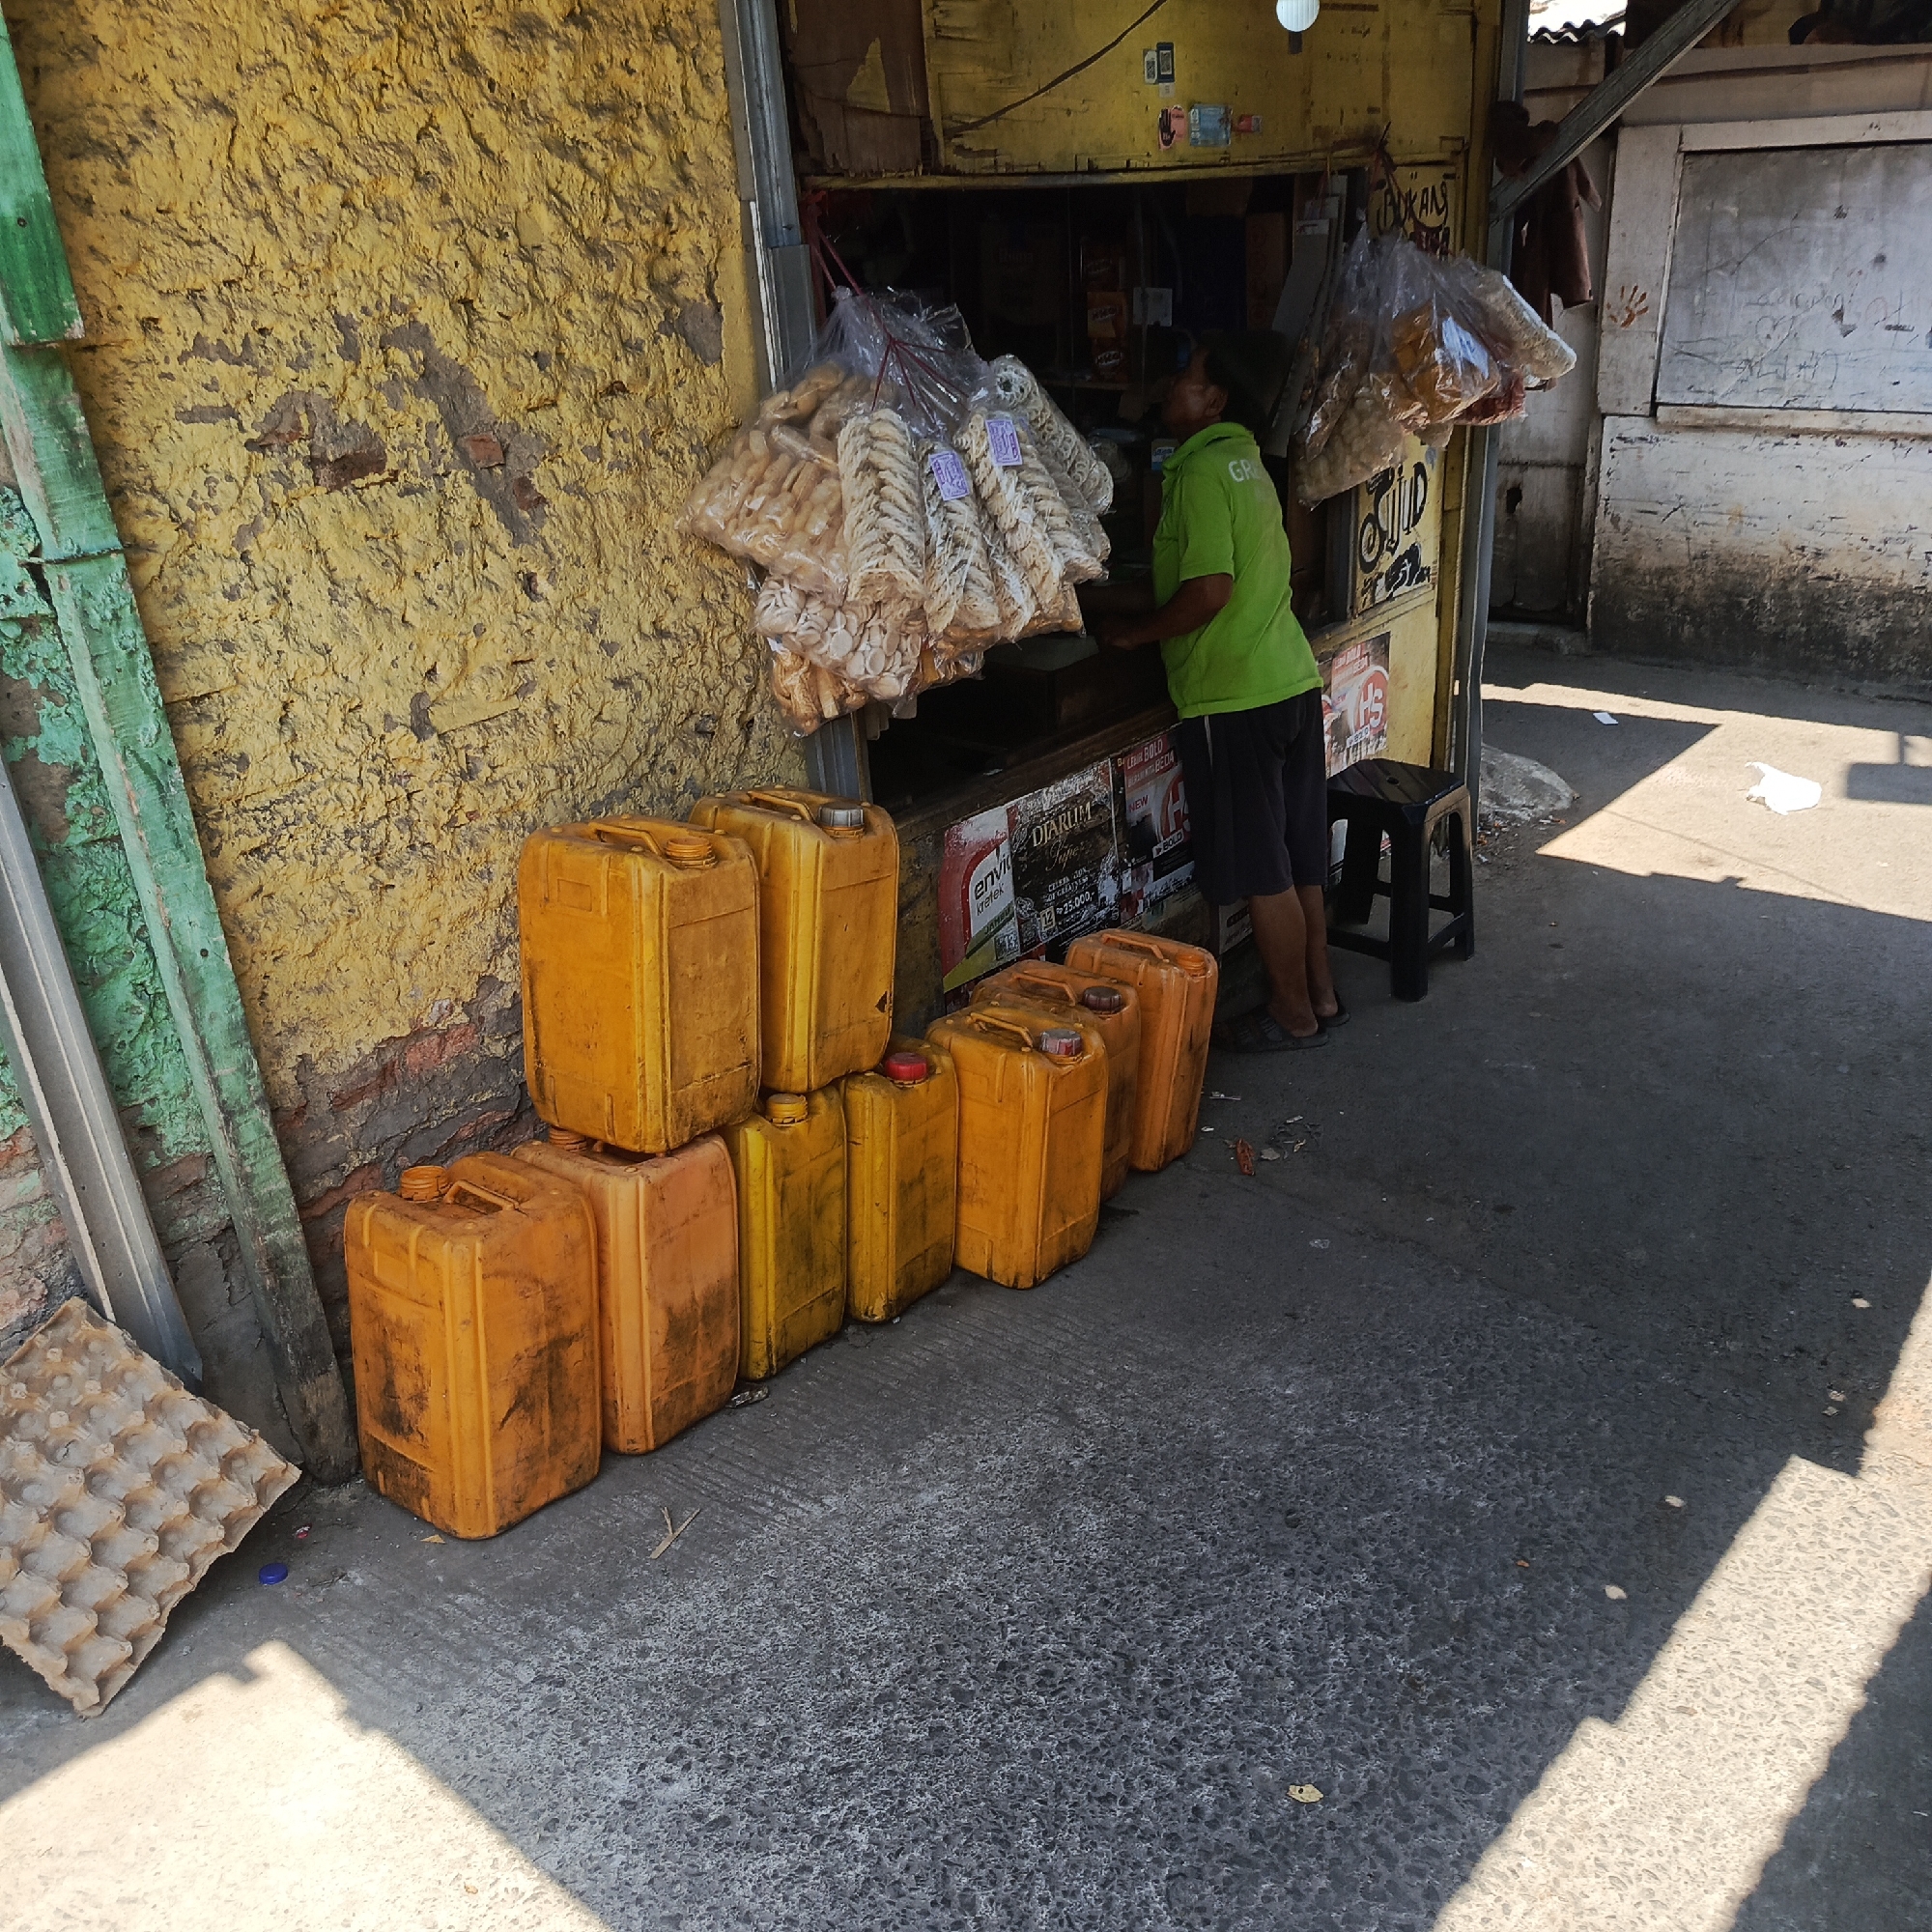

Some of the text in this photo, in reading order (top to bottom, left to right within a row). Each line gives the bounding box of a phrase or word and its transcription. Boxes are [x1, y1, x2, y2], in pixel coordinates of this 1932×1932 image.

[1359, 682, 1383, 728] HS
[1144, 738, 1163, 762] BOLD
[1155, 750, 1175, 773] BEDA
[1128, 794, 1149, 811] NEW
[1033, 801, 1092, 847] DJARUM
[1163, 832, 1183, 850] BOLD
[977, 883, 1005, 916] kretek
